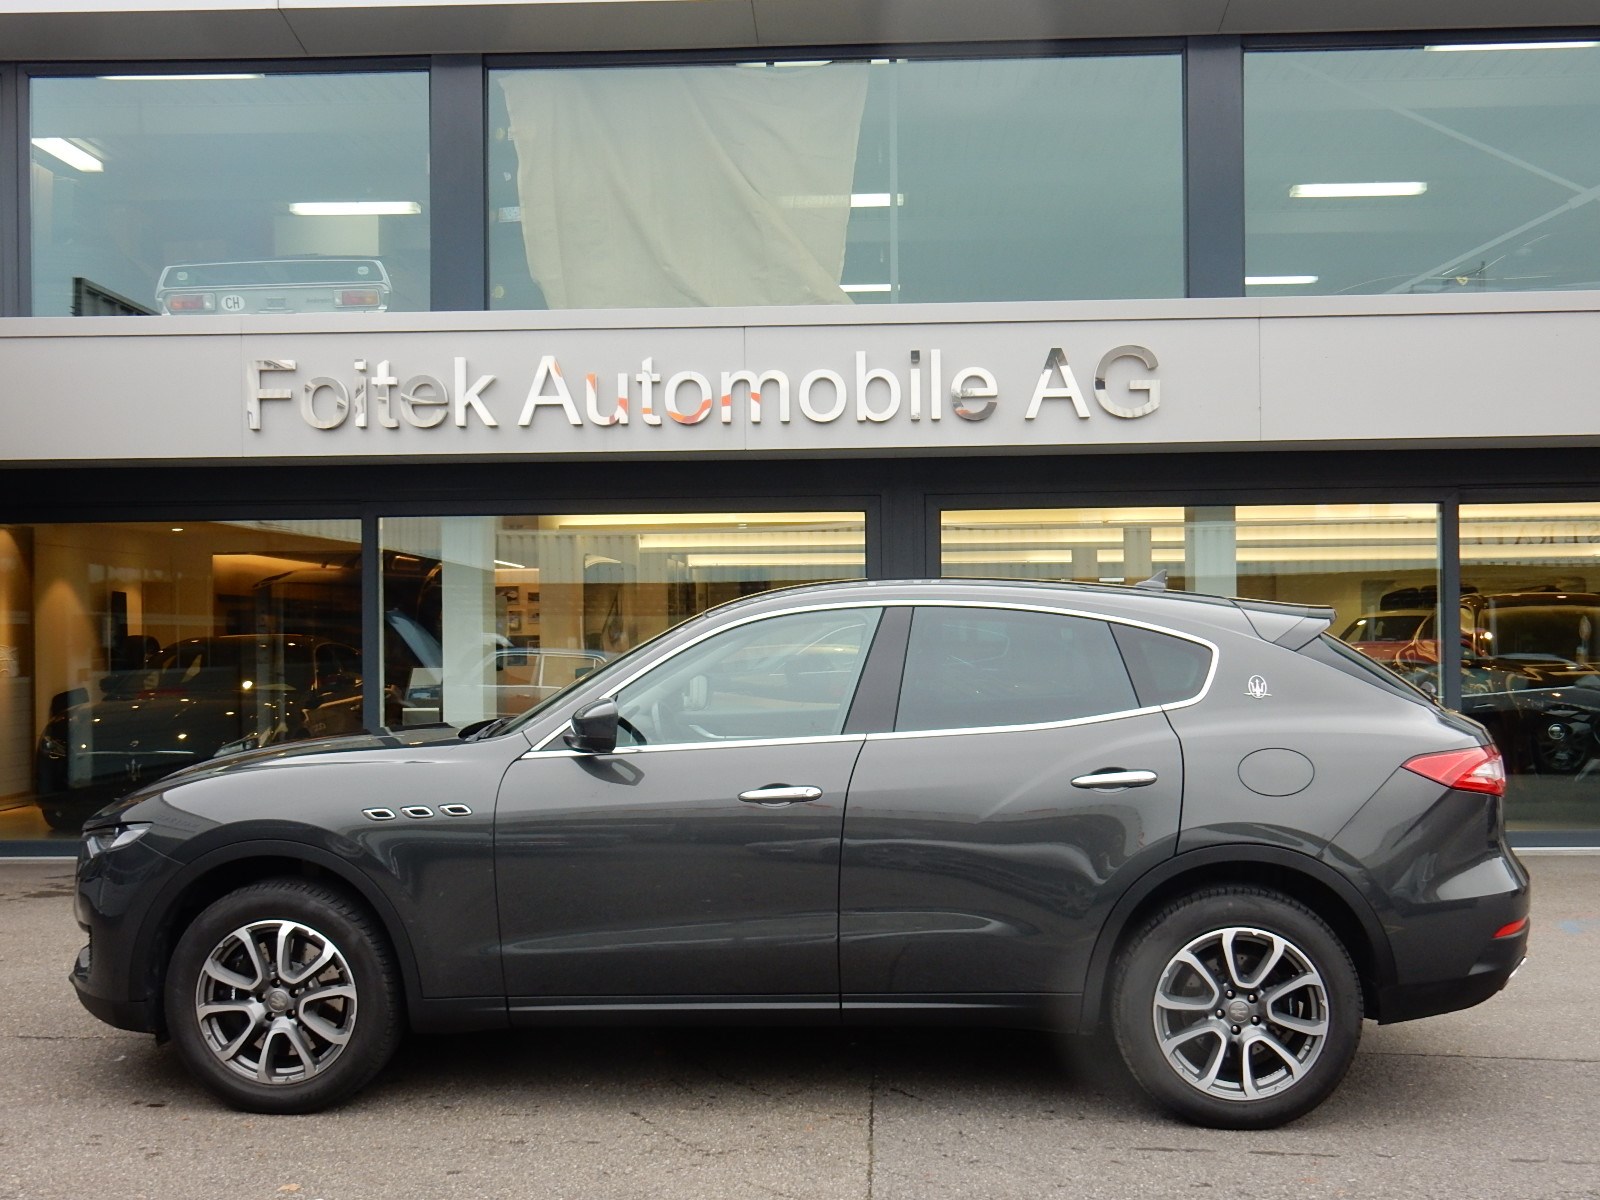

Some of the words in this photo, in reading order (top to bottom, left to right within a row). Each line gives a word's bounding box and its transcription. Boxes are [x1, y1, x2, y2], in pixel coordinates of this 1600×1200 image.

[225, 296, 240, 309] CH
[247, 357, 499, 430] Foitek
[517, 347, 998, 427] Automobile
[1025, 344, 1161, 420] AG
